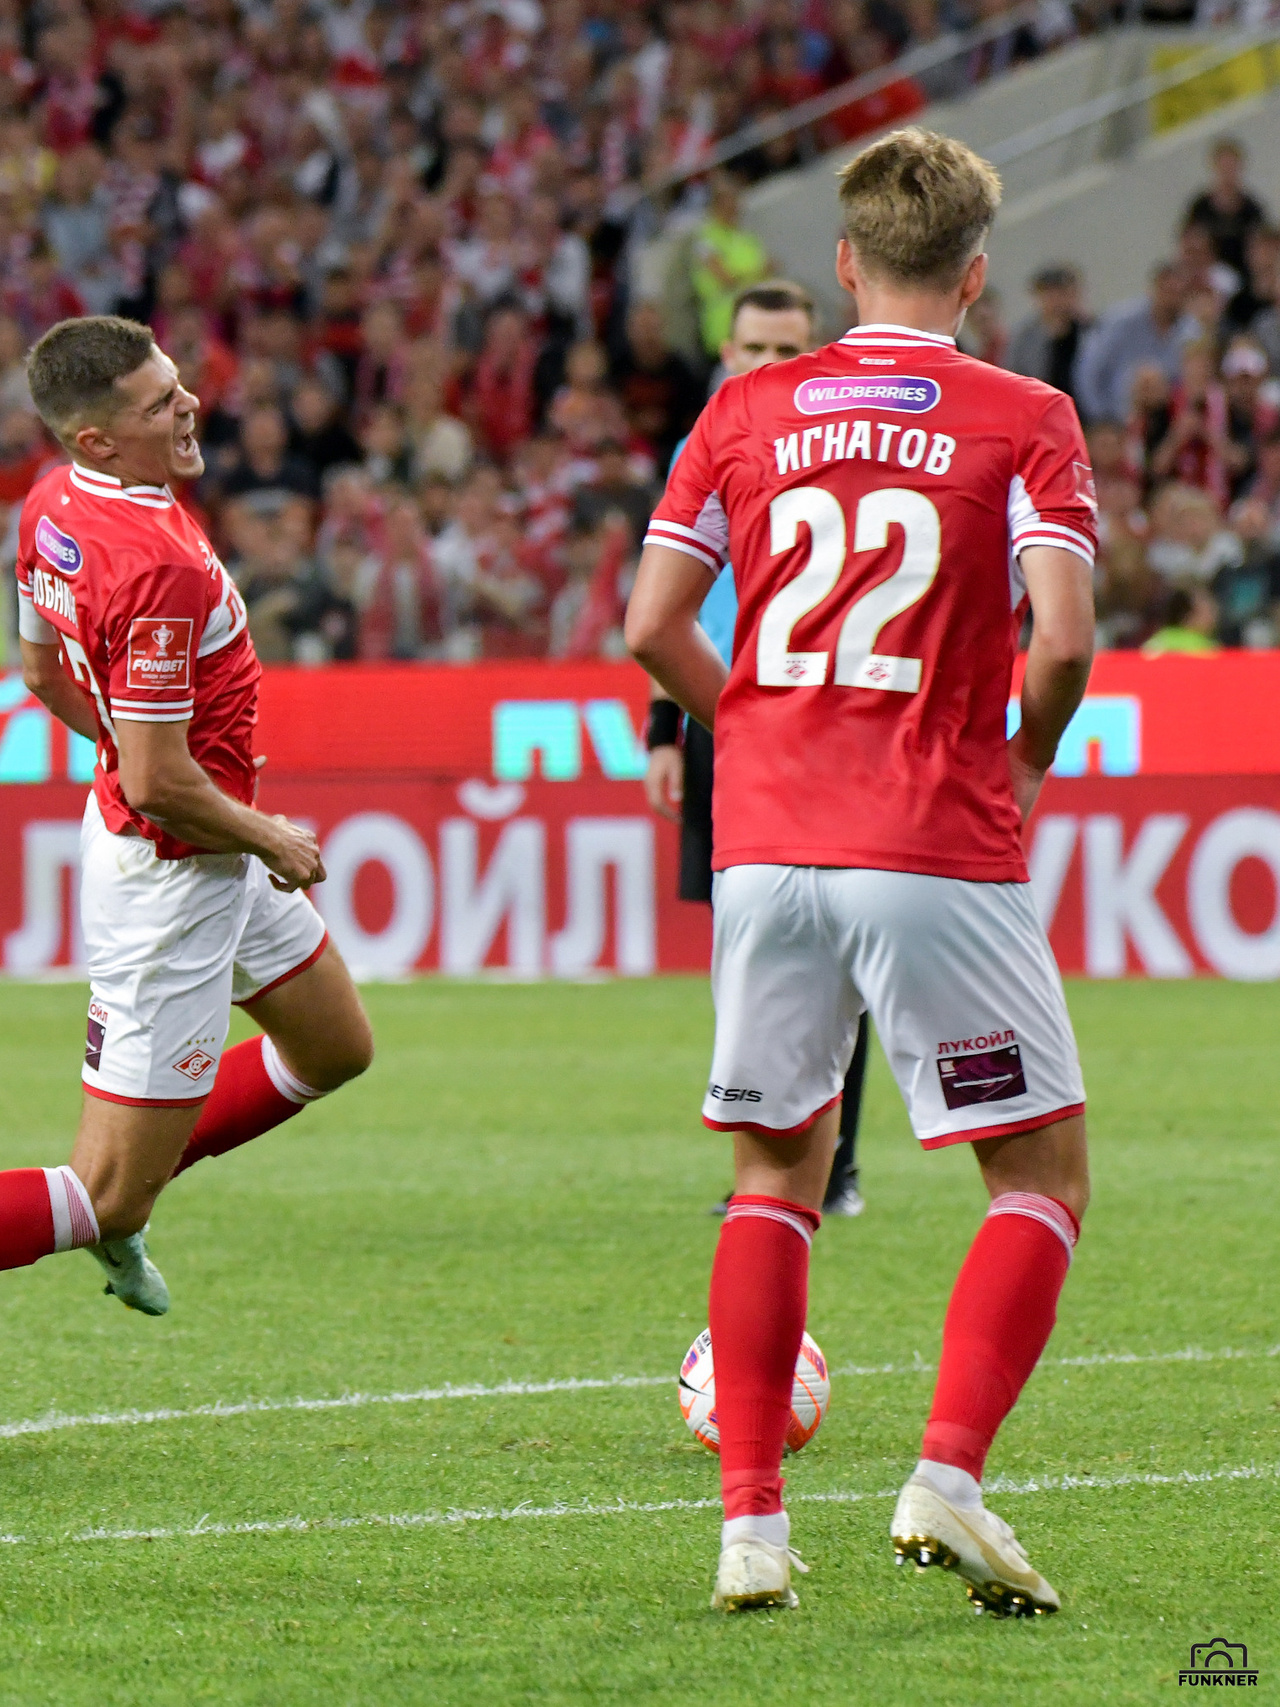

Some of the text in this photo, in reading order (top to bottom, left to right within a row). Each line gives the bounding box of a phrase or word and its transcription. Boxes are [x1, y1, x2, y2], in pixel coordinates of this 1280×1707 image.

[807, 386, 928, 402] WILDBERRIES
[773, 420, 957, 476] ИГНАТОВ
[756, 486, 942, 694] 22
[131, 659, 186, 673] FONBET
[937, 1029, 1016, 1055] ЛУКОЙЛ
